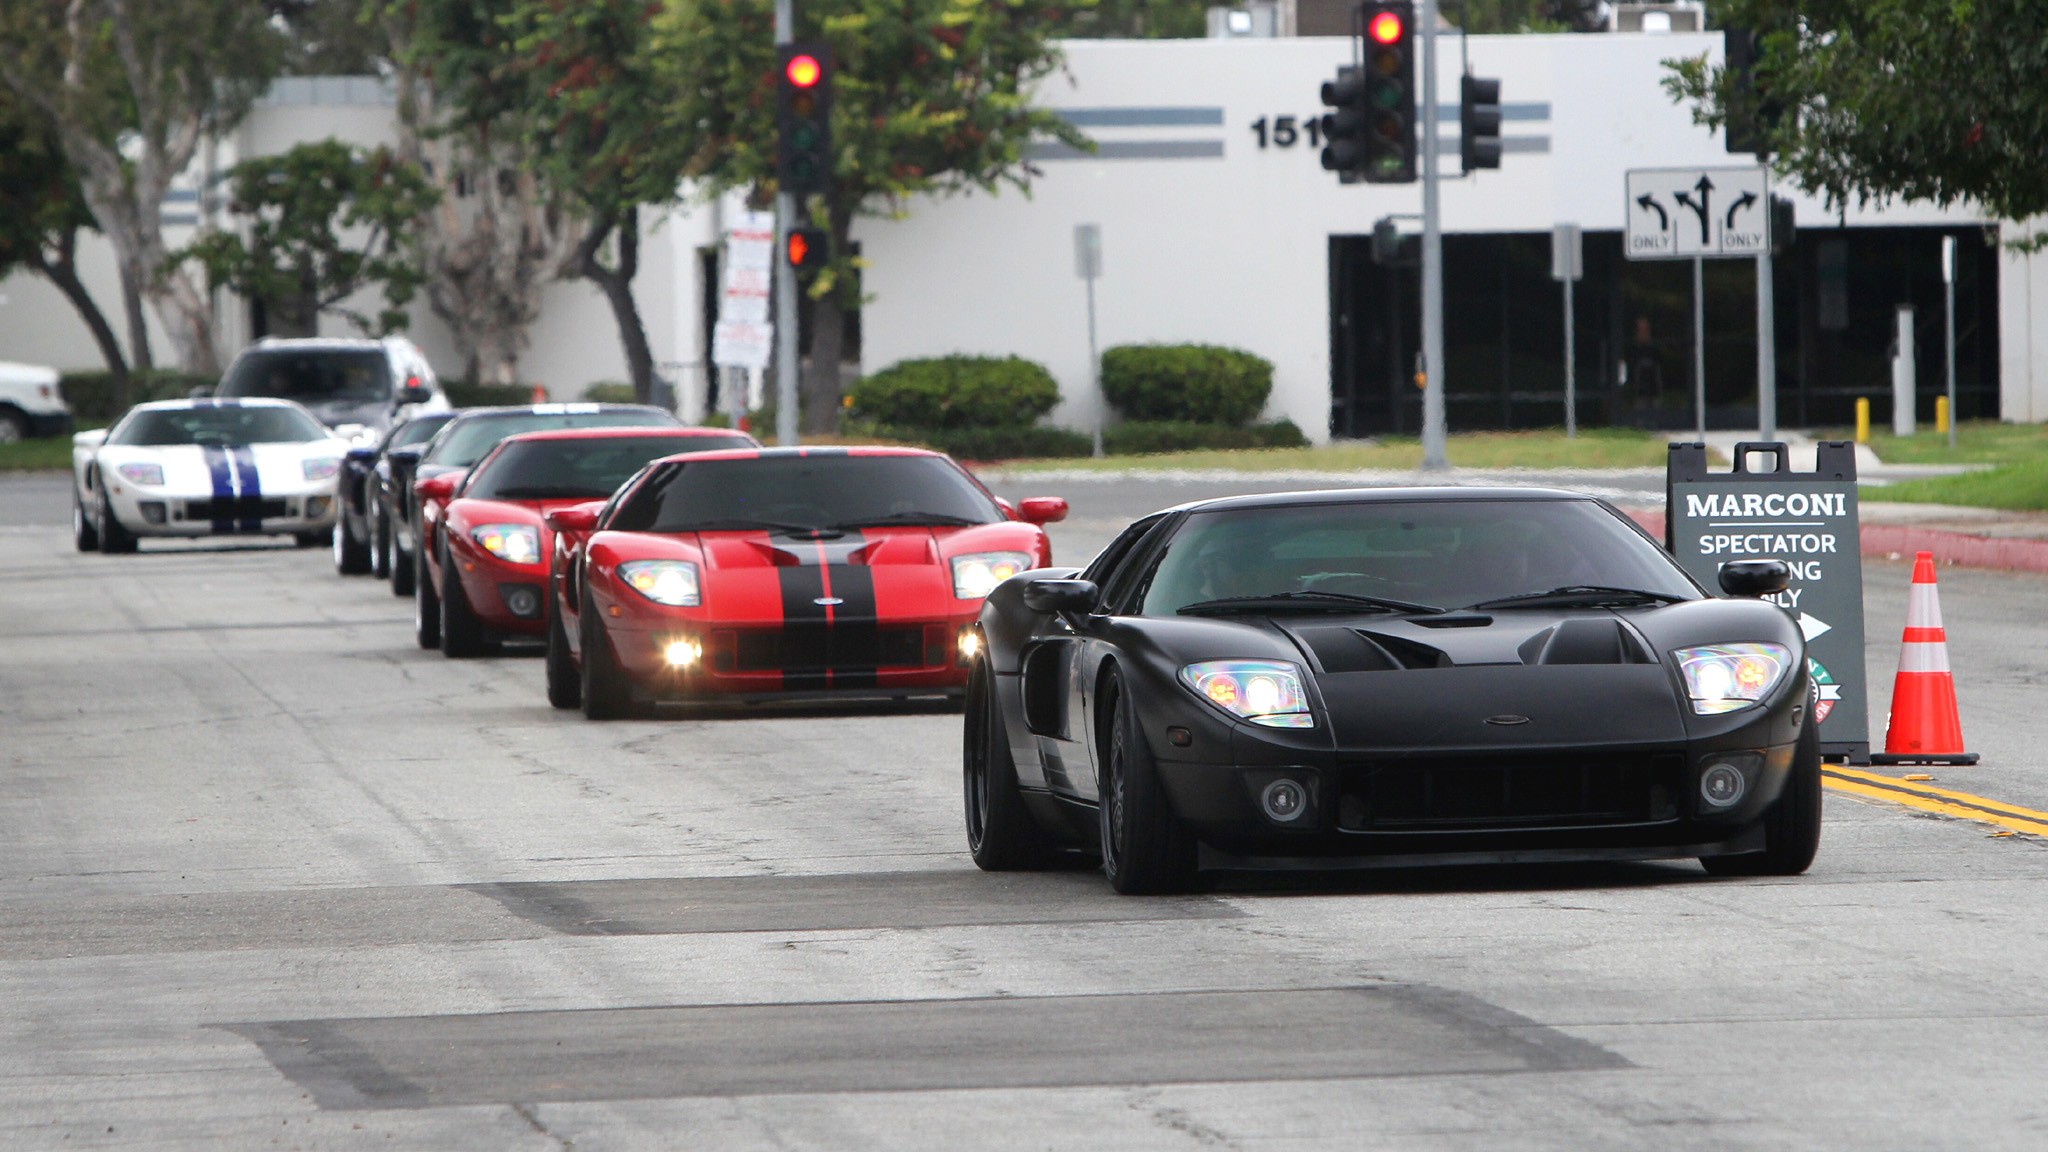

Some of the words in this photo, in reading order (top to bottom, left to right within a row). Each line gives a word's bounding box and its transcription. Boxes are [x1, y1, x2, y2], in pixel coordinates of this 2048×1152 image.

[1633, 235, 1670, 249] ONLY
[1725, 232, 1763, 246] ONLY
[1686, 493, 1846, 518] MARCONI
[1700, 533, 1837, 555] SPECTATOR
[1760, 588, 1802, 608] NLY
